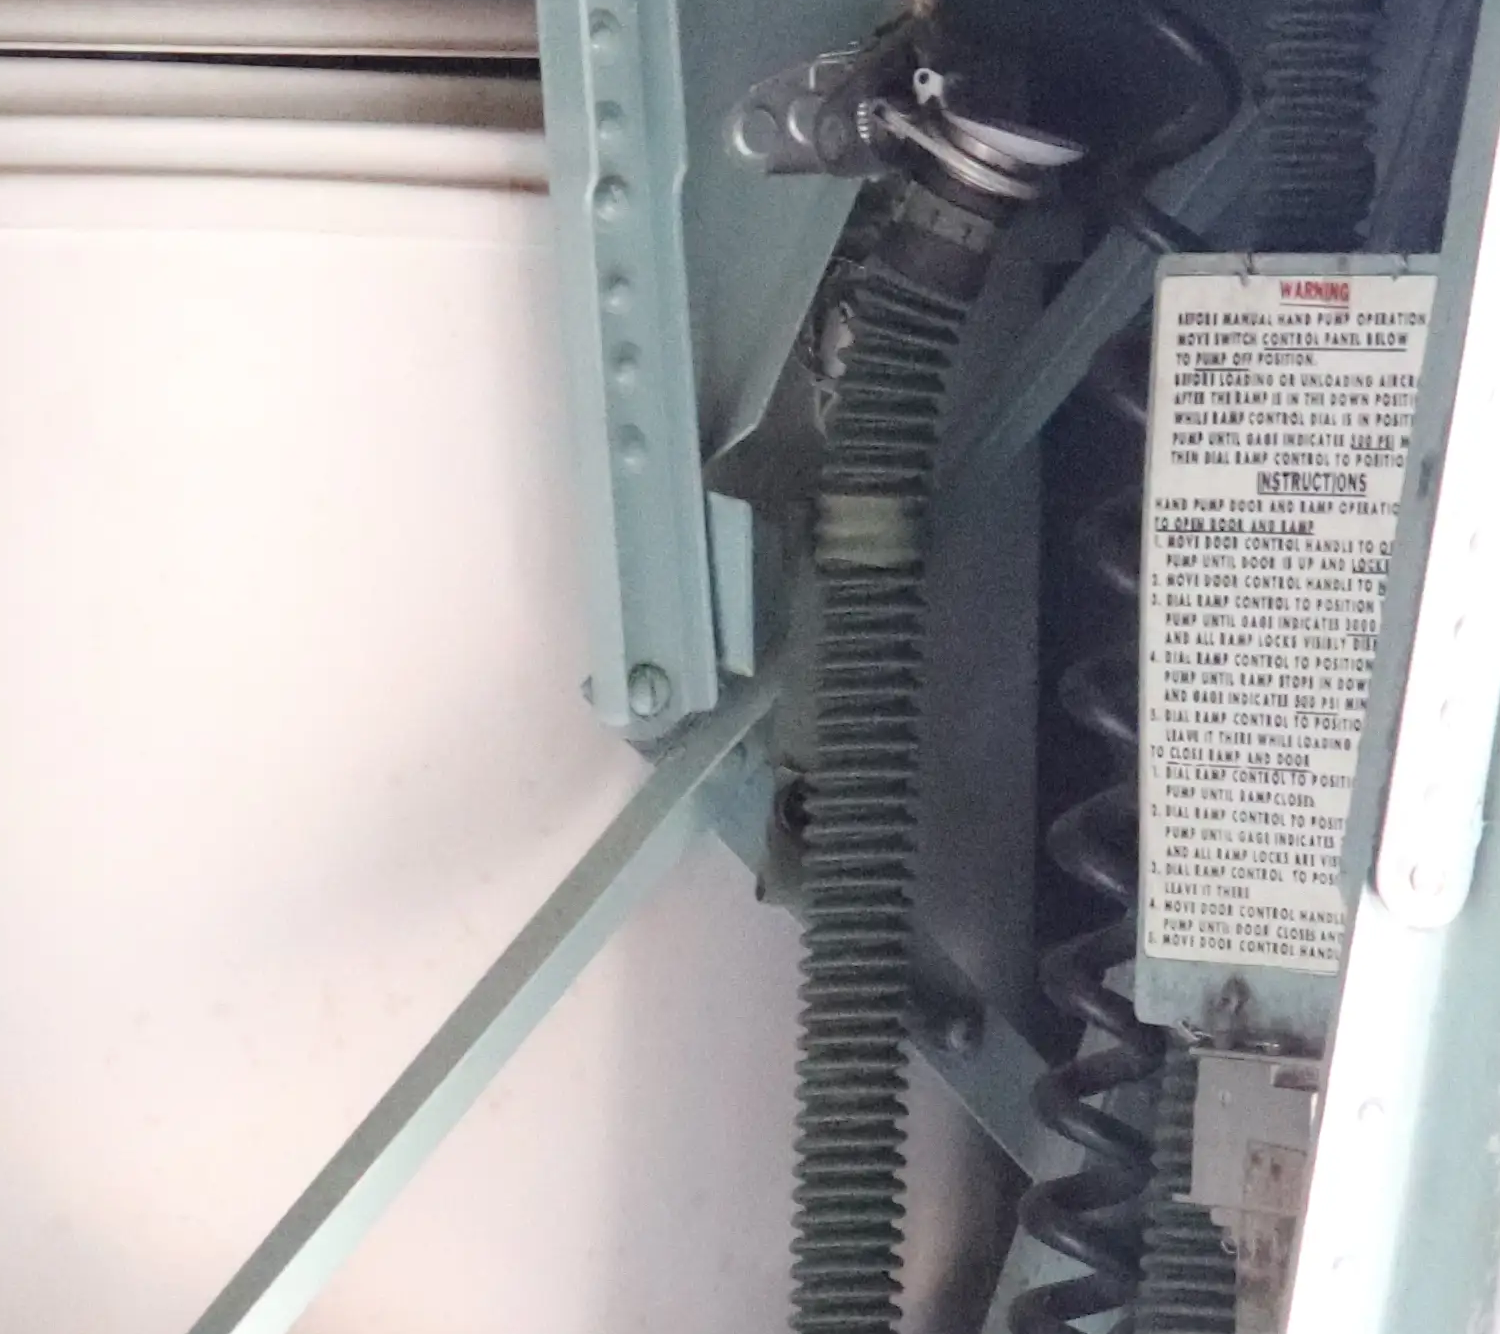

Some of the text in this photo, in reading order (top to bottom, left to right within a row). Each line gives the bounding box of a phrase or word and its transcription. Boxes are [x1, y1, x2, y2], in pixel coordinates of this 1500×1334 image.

[1280, 281, 1349, 302] WARNING
[1317, 312, 1349, 326] PUMP
[1263, 332, 1319, 346] CONTROL
[1256, 471, 1368, 493] INSTRUCTIONS
